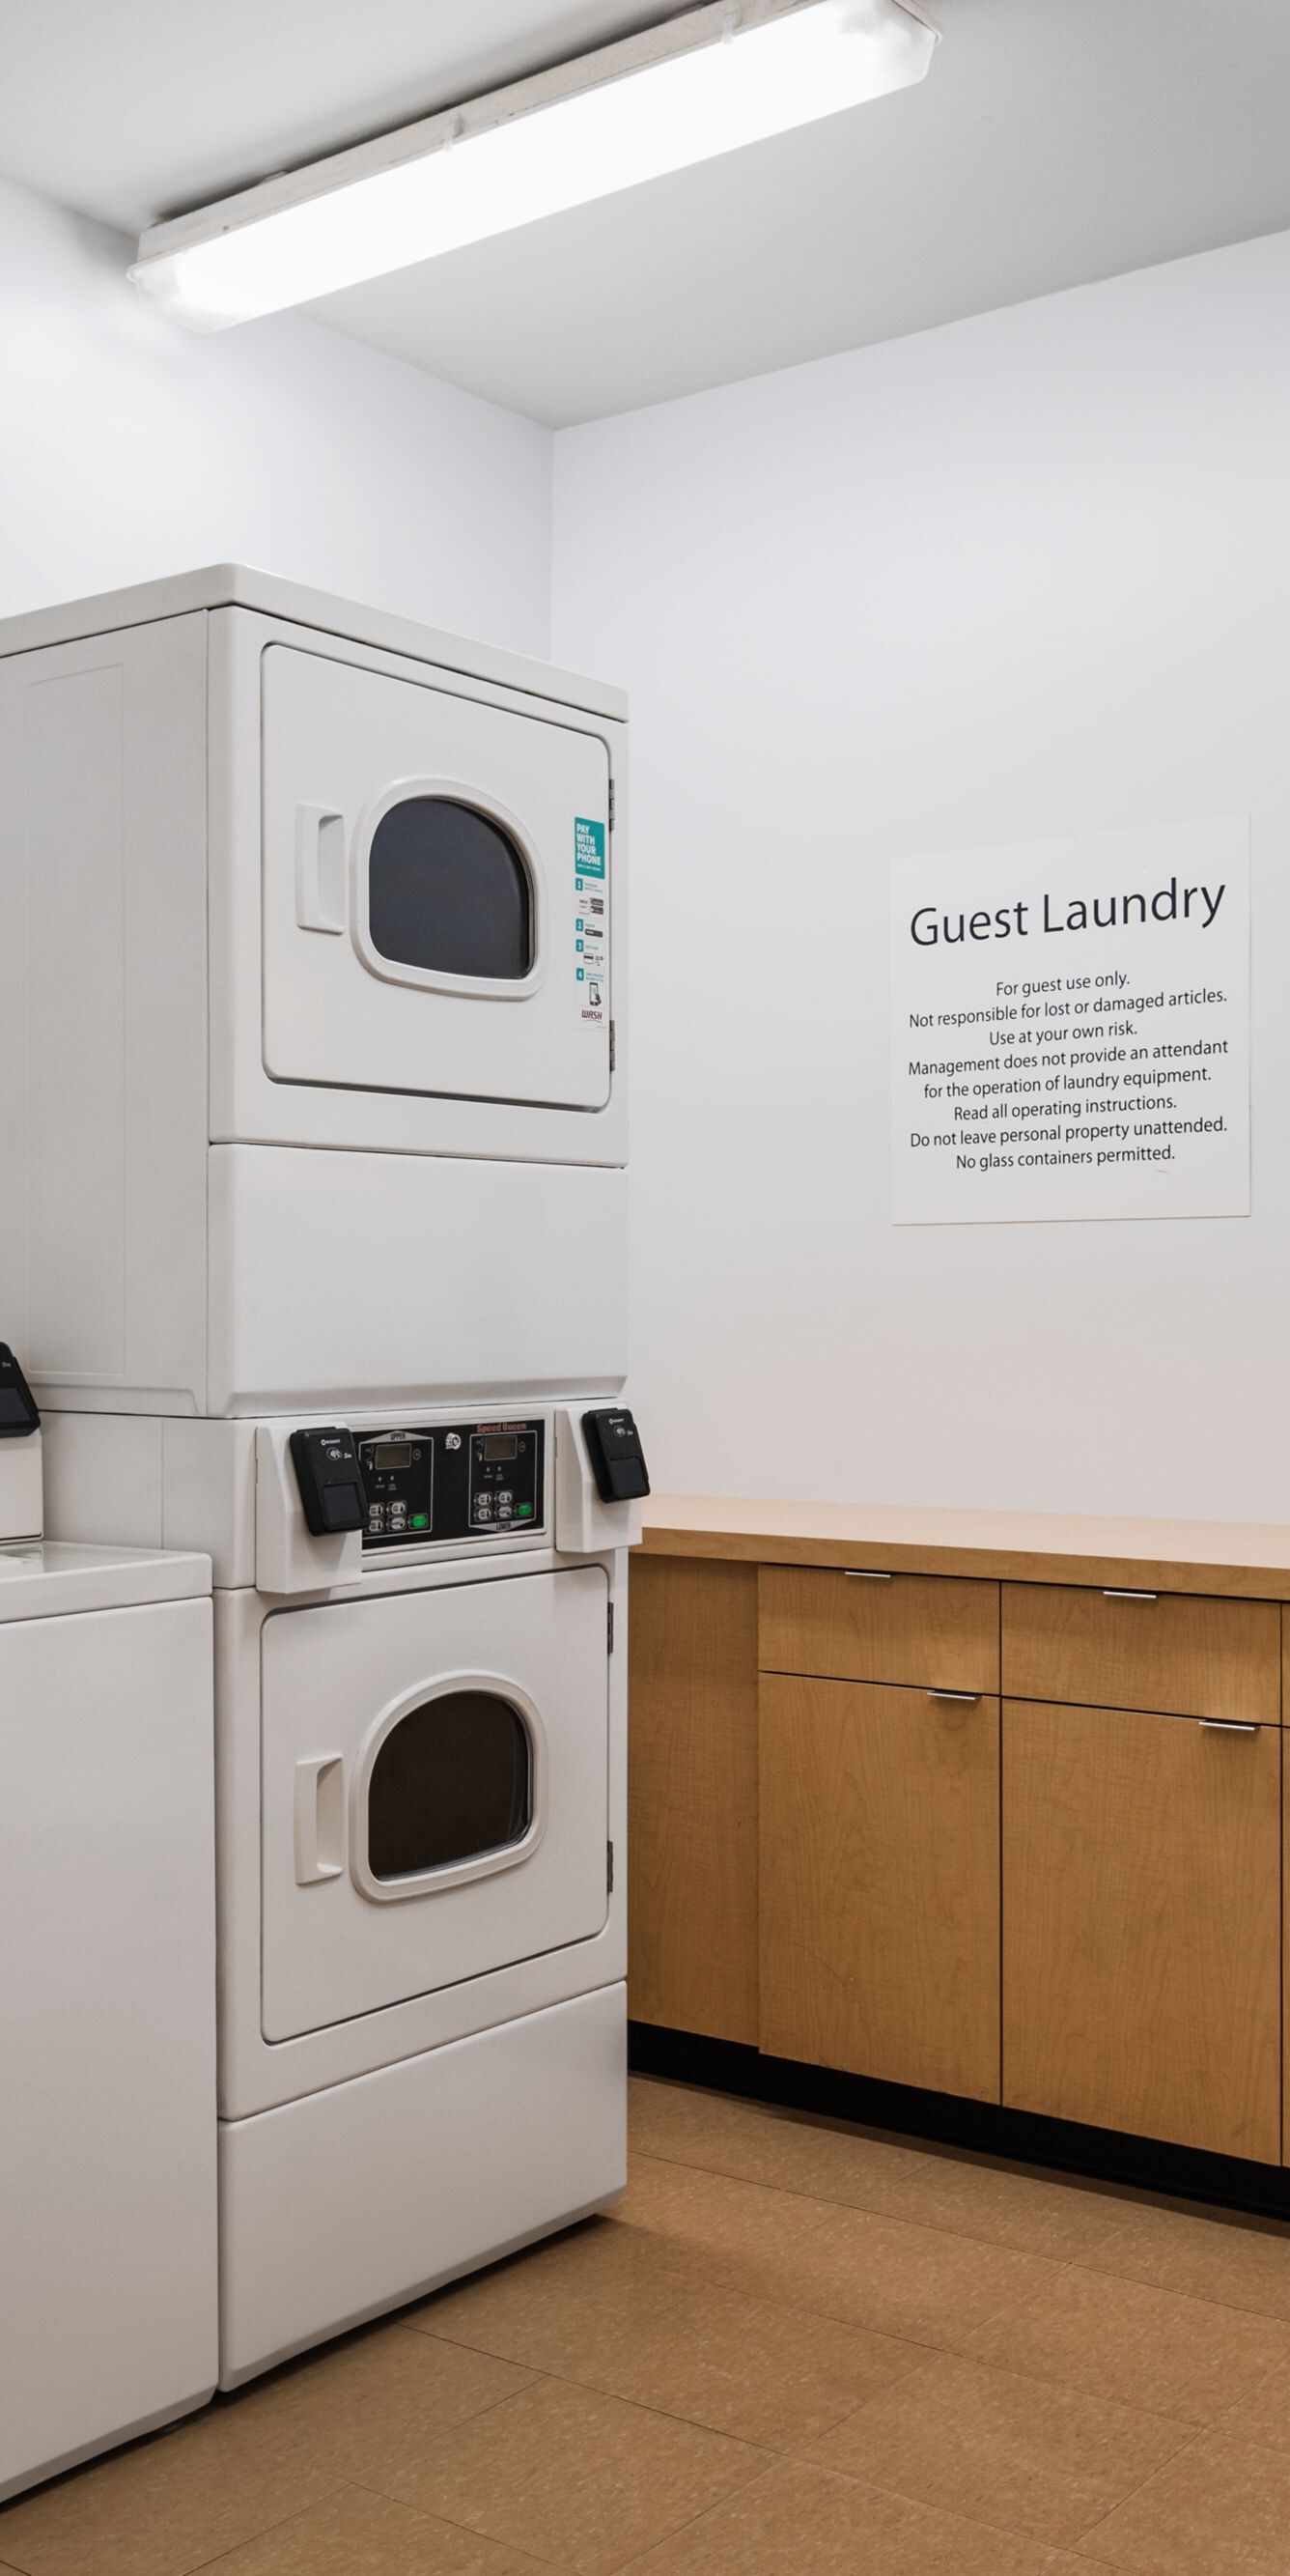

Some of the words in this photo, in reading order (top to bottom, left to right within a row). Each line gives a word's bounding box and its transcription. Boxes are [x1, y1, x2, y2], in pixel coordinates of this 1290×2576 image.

[576, 823, 590, 834] PAY
[576, 834, 595, 845] WITH
[576, 843, 597, 855] YOUR
[576, 853, 602, 865] PHONE
[911, 901, 1028, 946] Guest
[1044, 877, 1225, 933] Laundry
[996, 981, 1019, 996] For
[1022, 978, 1062, 998] guest
[1066, 977, 1091, 990] use
[1095, 971, 1130, 989] only.
[910, 1014, 934, 1028] Not
[938, 1005, 1018, 1028] responsible
[1021, 1004, 1041, 1018] for
[1045, 1002, 1070, 1016] lost
[1074, 1003, 1089, 1014] or
[1093, 992, 1164, 1013] damaged
[1168, 988, 1227, 1006] articles.
[990, 1032, 1015, 1046] Use
[1019, 1031, 1032, 1043] at
[1036, 1029, 1069, 1046] your
[1072, 1026, 1104, 1039] own
[1108, 1020, 1137, 1036] risk.
[909, 1058, 1000, 1077] Management
[1003, 1054, 1038, 1069] does
[1042, 1053, 1066, 1066] not
[1070, 1046, 1126, 1068] provide
[1130, 1048, 1148, 1060] an
[1152, 1039, 1228, 1059] attendant
[924, 1084, 943, 1098] for
[946, 1082, 969, 1097] the
[972, 1078, 1041, 1098] operation
[1045, 1075, 1060, 1090] of
[1064, 1072, 1119, 1090] laundry
[1123, 1067, 1211, 1089] equipment.
[954, 1105, 988, 1120] Read
[992, 1103, 1007, 1118] all
[1011, 1100, 1081, 1120] operating
[1086, 1095, 1177, 1113] instructions.
[911, 1133, 930, 1147] Do
[934, 1133, 957, 1146] not
[961, 1130, 996, 1145] leave
[1000, 1124, 1061, 1146] personal
[1066, 1124, 1130, 1143] property
[1134, 1116, 1227, 1136] unattended.
[957, 1155, 976, 1169] No
[979, 1153, 1014, 1172] glass
[1018, 1150, 1093, 1167] containers
[1097, 1144, 1175, 1167] permitted.
[477, 1423, 501, 1433] Speed
[495, 1522, 512, 1531] LOWER
